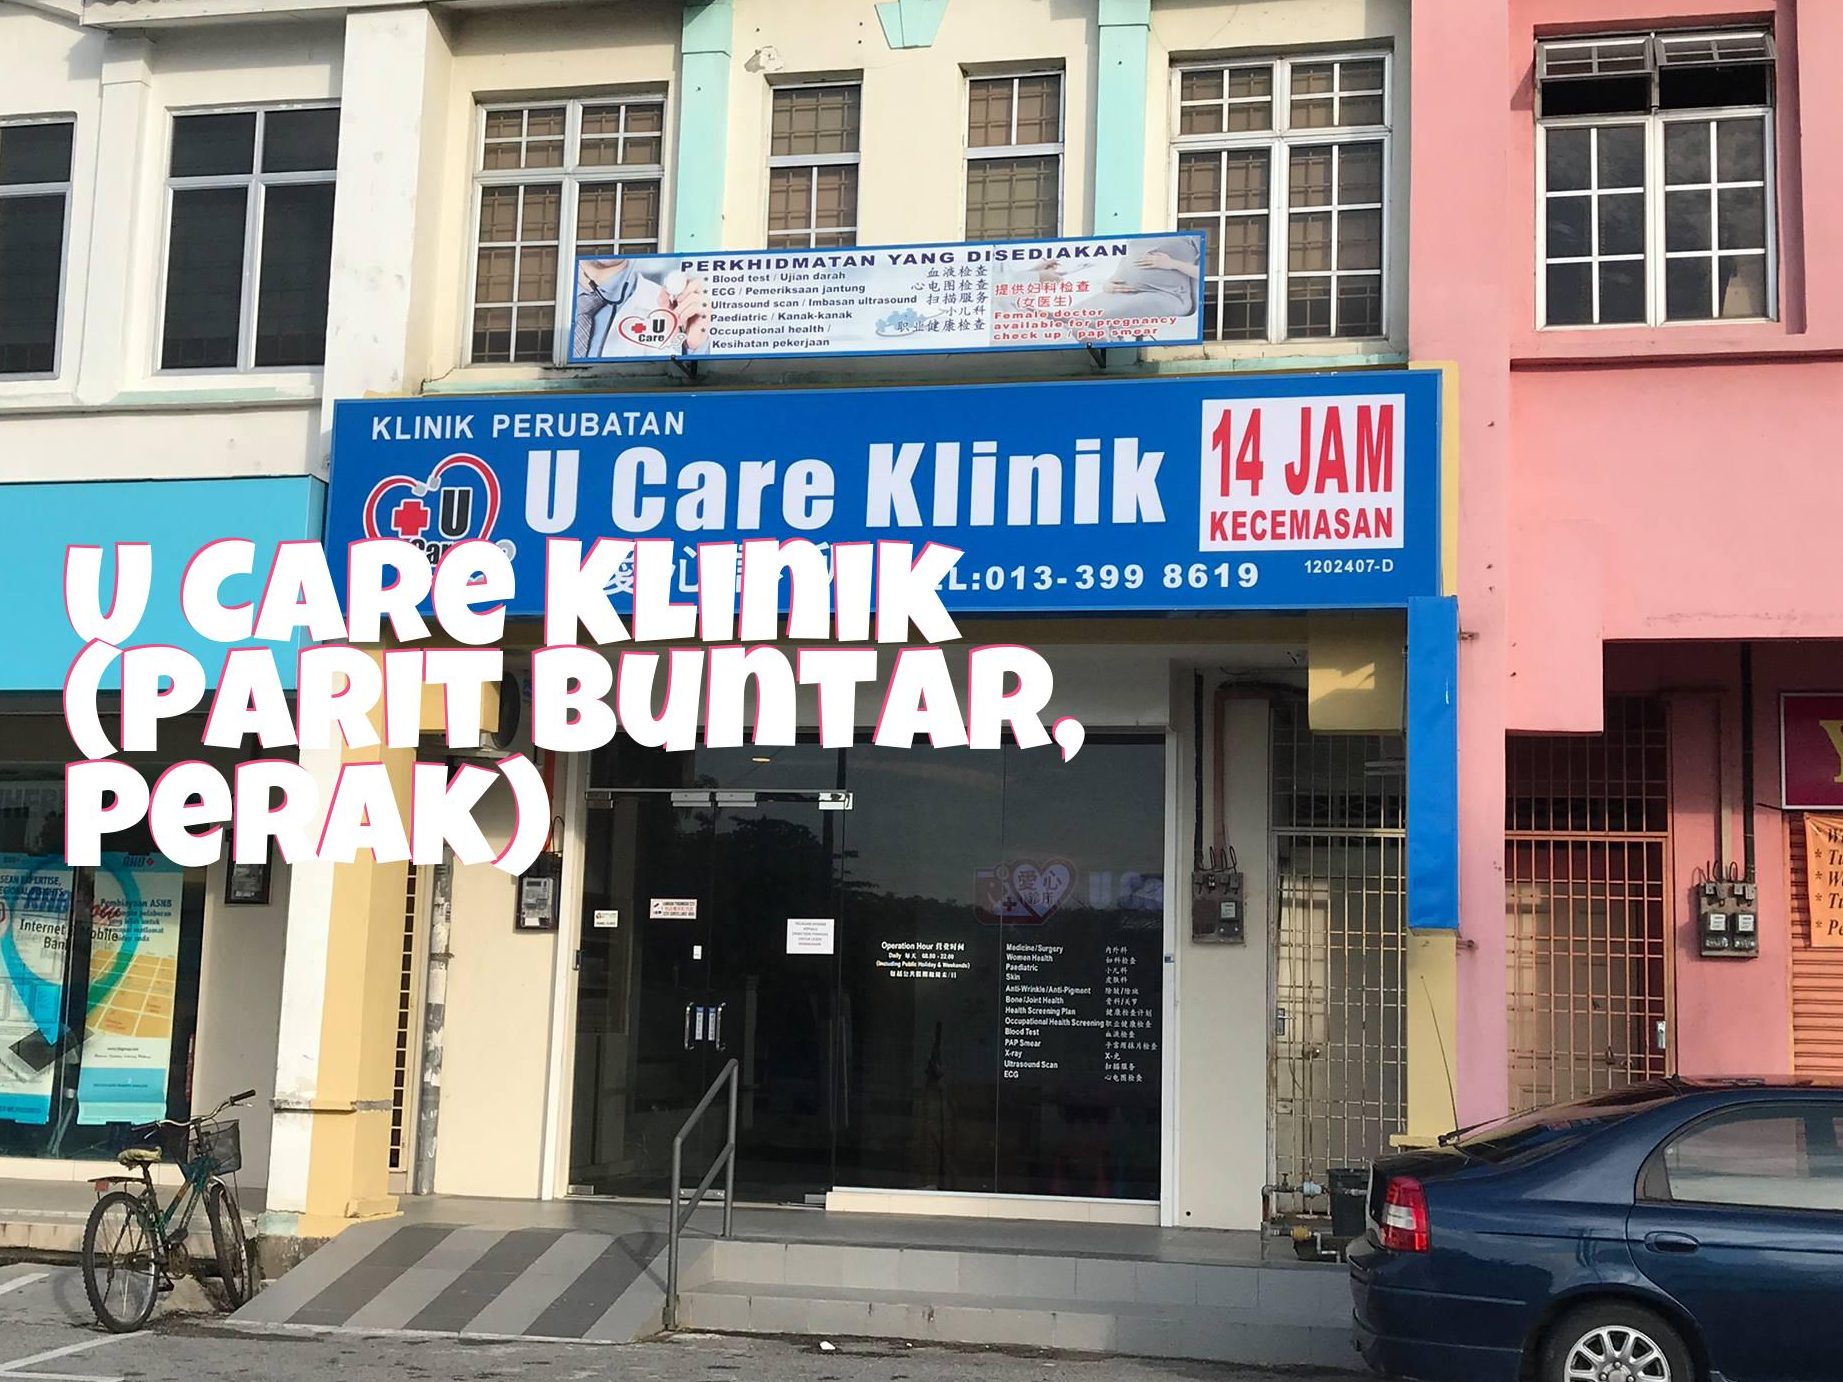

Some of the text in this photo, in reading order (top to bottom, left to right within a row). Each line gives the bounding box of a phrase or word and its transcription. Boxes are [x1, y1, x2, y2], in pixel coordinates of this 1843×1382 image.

[680, 244, 1128, 273] PERKHIDMATAN YANG DISEDIAKAN
[712, 274, 745, 283] Blood
[748, 273, 770, 282] test
[780, 272, 809, 283] Ujian
[813, 271, 846, 280] darah
[926, 264, 988, 278] 血液检查
[711, 287, 736, 296] ECG
[745, 285, 819, 296] Pemeriksaan
[822, 284, 866, 295] jantung
[911, 278, 988, 292] 心电图检查
[995, 280, 1090, 296] 提供妇科检查
[710, 300, 770, 309] Ultrasound
[773, 300, 799, 308] scan
[808, 298, 855, 307] Imbasan
[858, 295, 917, 305] ultrasound
[926, 291, 988, 305] 扫描服务
[710, 313, 768, 322] Paediatric
[778, 310, 853, 321] Kanak-kanak
[945, 304, 986, 316] 小儿科
[994, 308, 1104, 319] Female doctor
[652, 318, 666, 333] U
[993, 317, 1177, 330] available for pregnancy
[709, 326, 785, 336] Occupational
[788, 325, 824, 333] health
[993, 331, 1040, 340] check
[1044, 331, 1061, 340] up
[1078, 330, 1105, 339] pap
[1111, 327, 1158, 336] smear
[638, 333, 665, 342] Care
[712, 339, 830, 349] Kesihatan pekerjaan
[371, 411, 685, 441] KLINIK PERUBATAN
[1212, 404, 1394, 497] 14 JAM
[525, 437, 1167, 534] U Care Klinik
[439, 487, 472, 537] U
[1209, 507, 1393, 542] KECEMASAN
[1304, 558, 1394, 574] 1202407-D
[934, 562, 1259, 591] L:013-399 8619
[20, 918, 67, 935] Internet
[881, 941, 915, 951] Operation
[916, 942, 933, 950] Hour
[1006, 943, 1063, 954] Medicine/Surgery
[888, 952, 902, 960] Daily
[1032, 954, 1053, 962] Health
[1005, 963, 1039, 972] Paediatric
[1005, 973, 1021, 981] Skin
[1042, 996, 1064, 1004] Health
[1005, 1006, 1076, 1017] Health Screening Plan
[1005, 1018, 1104, 1029] Occupational Health Screening
[1004, 1028, 1040, 1036] Blood Test
[1004, 1039, 1041, 1048] PAP Smear
[1004, 1049, 1023, 1058] X-ray
[1004, 1060, 1059, 1069] Ultrasound Scan
[1004, 1070, 1019, 1079] ECG
